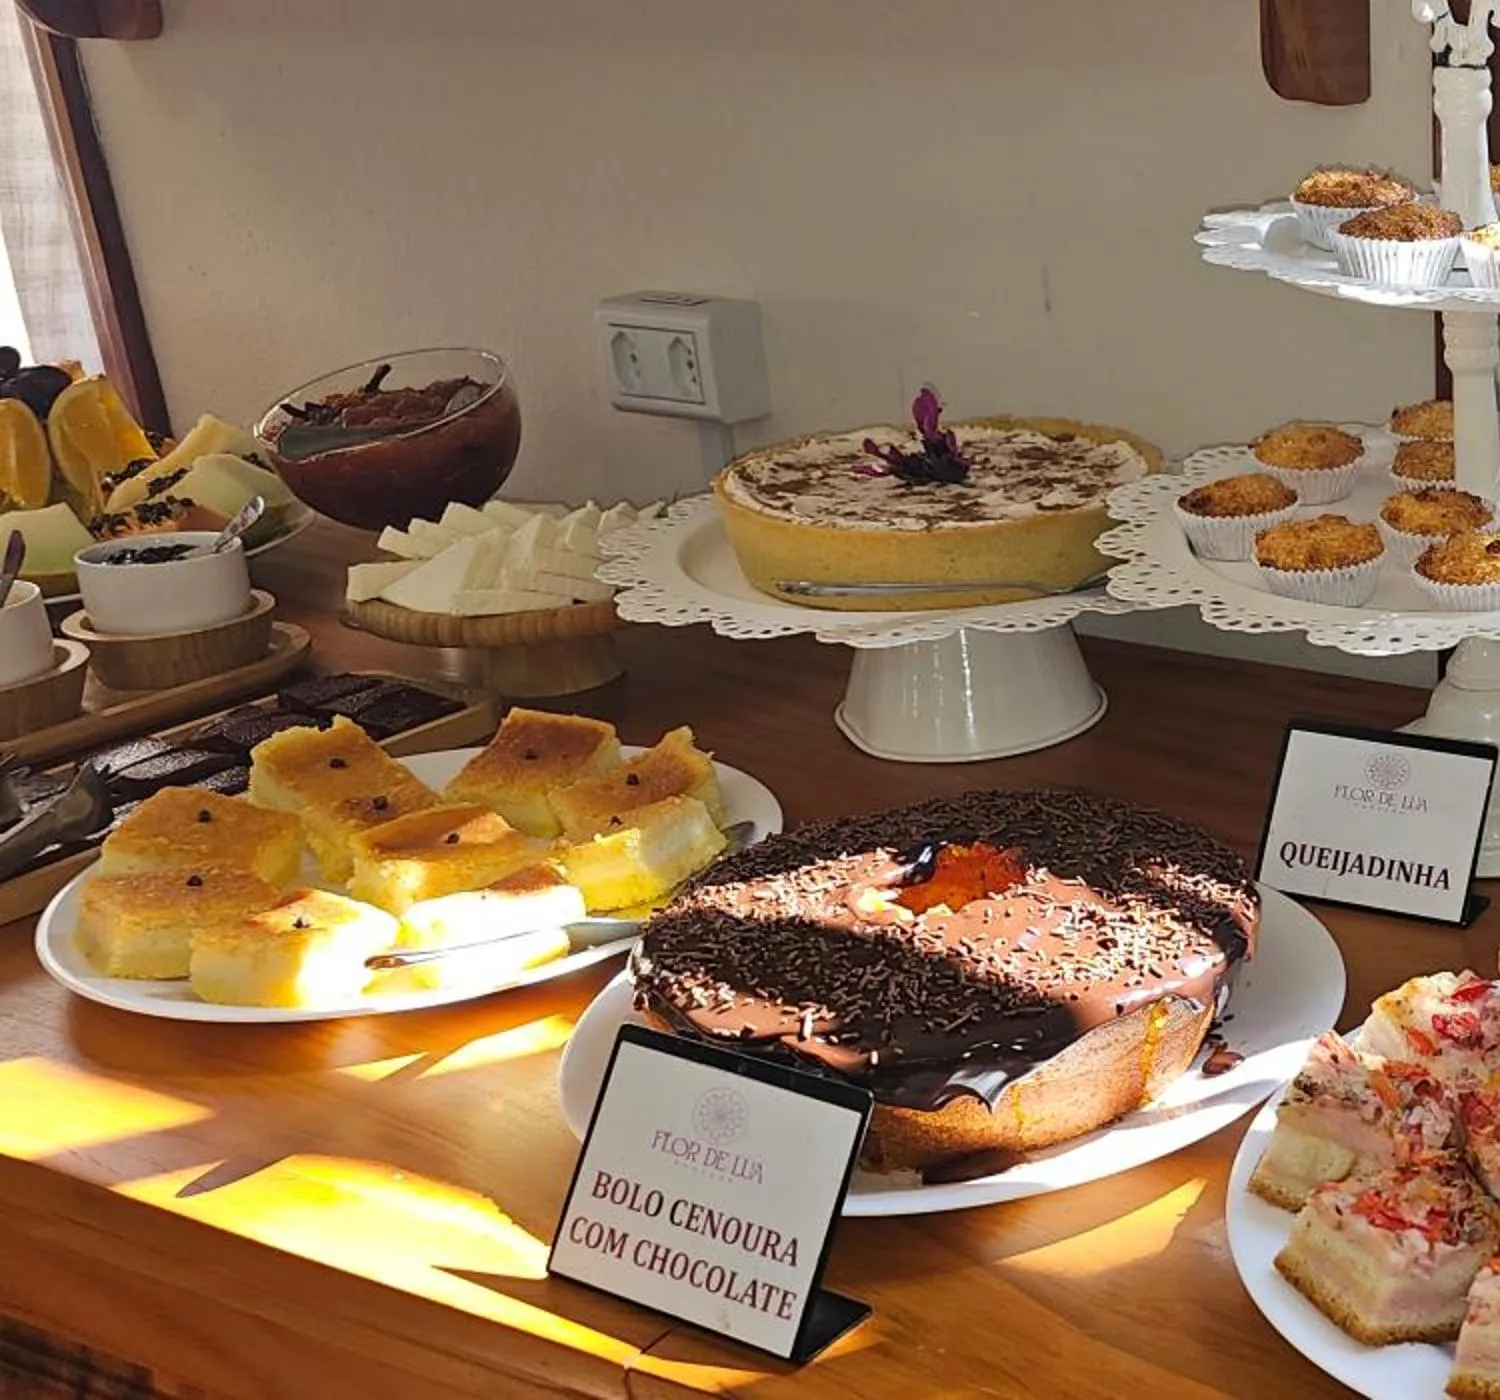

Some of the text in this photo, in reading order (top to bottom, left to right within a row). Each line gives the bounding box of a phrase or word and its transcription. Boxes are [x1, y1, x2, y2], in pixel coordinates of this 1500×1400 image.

[1279, 841, 1450, 890] QUEIJADINHA
[652, 1130, 701, 1162] FLOR
[704, 1147, 730, 1170] DE
[731, 1156, 763, 1184] LUA
[591, 1170, 664, 1217] BOLO
[669, 1199, 799, 1267] CENOURA
[569, 1216, 797, 1321] COM CHOCOLATE
